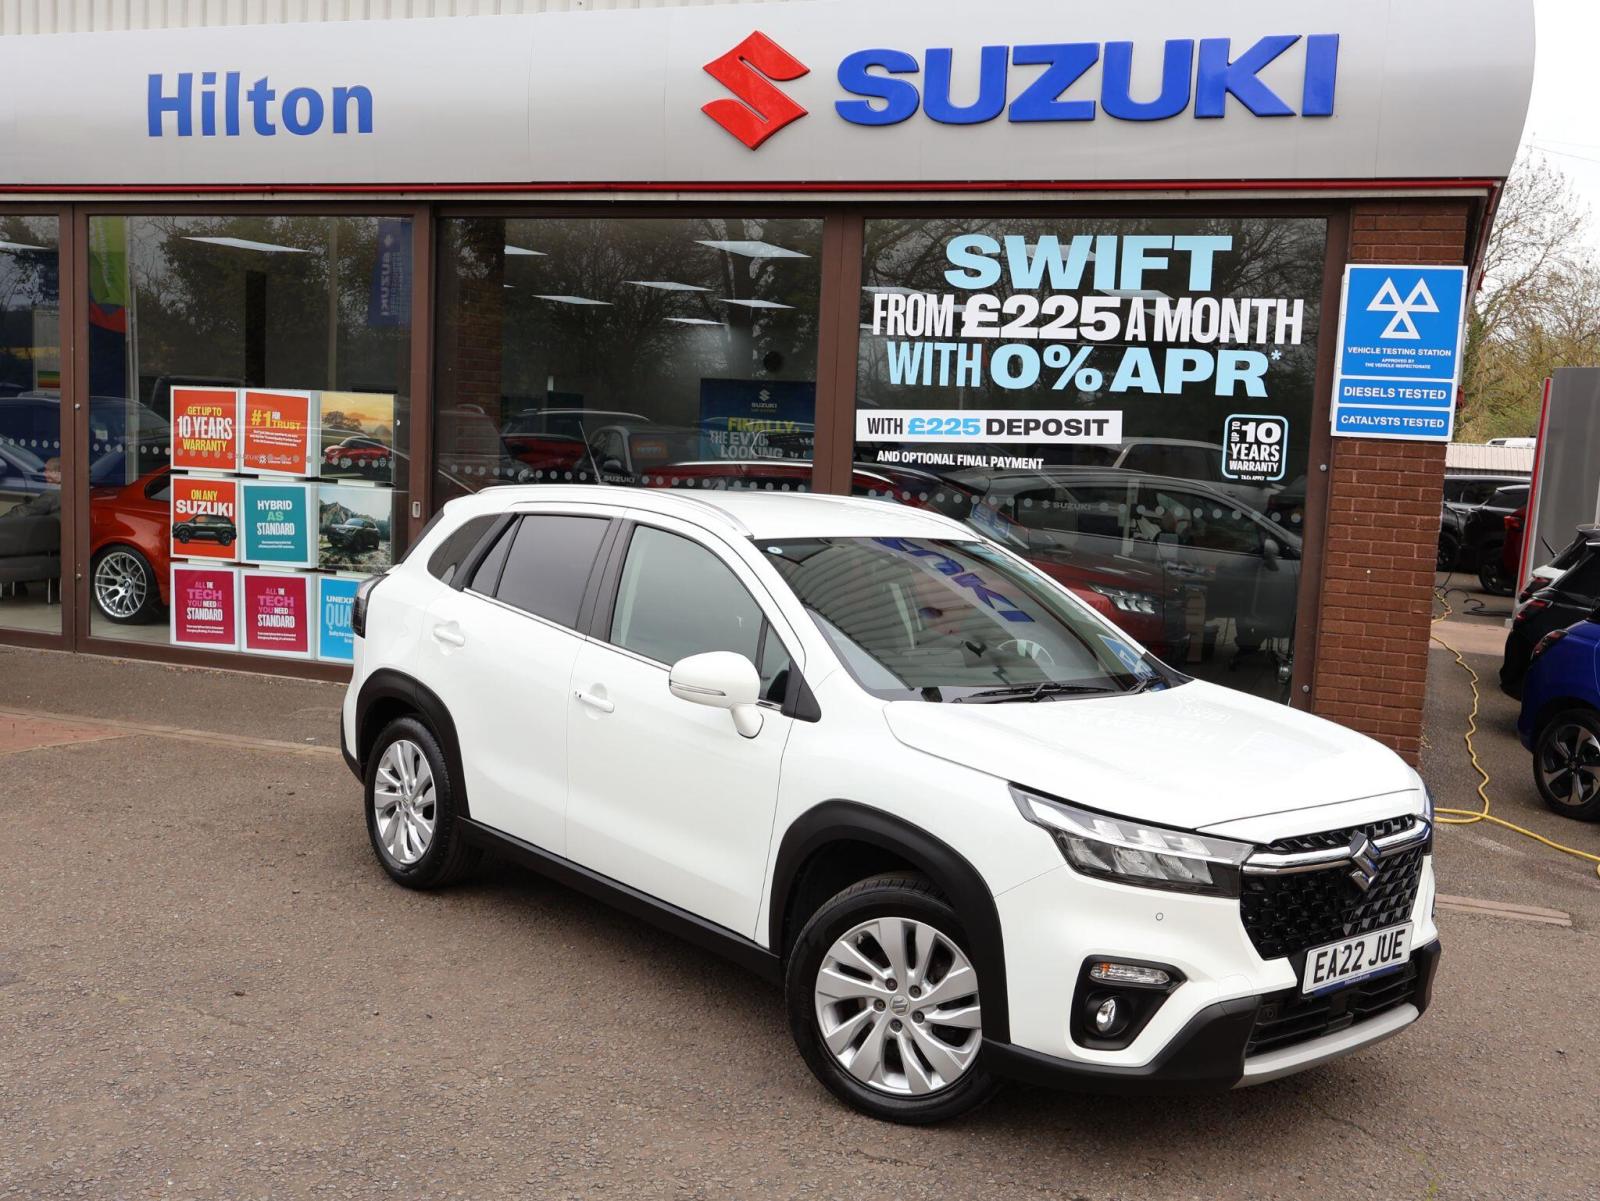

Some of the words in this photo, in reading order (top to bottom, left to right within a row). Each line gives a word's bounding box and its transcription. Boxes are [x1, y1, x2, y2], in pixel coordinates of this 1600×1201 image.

[835, 33, 1339, 126] SUZUKI
[148, 71, 373, 136] Hilton
[944, 234, 1232, 291] SWIFT
[873, 293, 954, 337] FROM
[961, 293, 1121, 341] £225
[1125, 297, 1145, 341] A
[1153, 297, 1304, 344] MONTH
[1417, 348, 1452, 356] STATION
[887, 341, 982, 388] WITH
[990, 343, 1103, 392] 0%
[1344, 386, 1396, 398] DIESELS
[1398, 388, 1447, 400] TESTED
[187, 406, 202, 415] GET
[202, 406, 212, 416] UP
[212, 407, 222, 416] TO
[251, 409, 272, 428] #1
[272, 420, 301, 430] TRUST
[1341, 415, 1400, 426] CATALYSTS
[1402, 417, 1445, 428] TESTED
[177, 416, 192, 438] 10
[192, 416, 233, 440] YEARS
[867, 417, 903, 435] WITH
[908, 417, 981, 436] £225
[986, 418, 1109, 437] DEPOSIT
[1231, 421, 1241, 430] TO
[1231, 432, 1240, 442] UP
[1241, 421, 1281, 444] 10
[183, 439, 227, 451] WARRANTY
[1230, 443, 1280, 462] YEARS
[877, 450, 900, 463] AND
[901, 452, 955, 466] OPTIONAL
[957, 455, 988, 468] FINAL
[990, 456, 1044, 470] PAYMENT
[1229, 460, 1279, 472] WARRANTY
[191, 489, 202, 500] ON
[203, 489, 217, 501] ANY
[175, 499, 233, 517] SUZUKI
[257, 500, 292, 510] HYBRID
[1053, 502, 1091, 511] SUZUKI
[266, 511, 284, 521] AS
[256, 522, 295, 535] STANDARD
[195, 581, 206, 589] ALL
[265, 587, 277, 595] ALL
[187, 589, 222, 600] TECH
[257, 595, 294, 607] TECH
[187, 599, 202, 607] YOU
[202, 600, 217, 608] NEED
[186, 607, 223, 621] STANDARD
[273, 607, 288, 615] NEED
[257, 614, 295, 629] STANDARD
[1313, 940, 1365, 984] EA22
[1368, 928, 1406, 966] JUE
